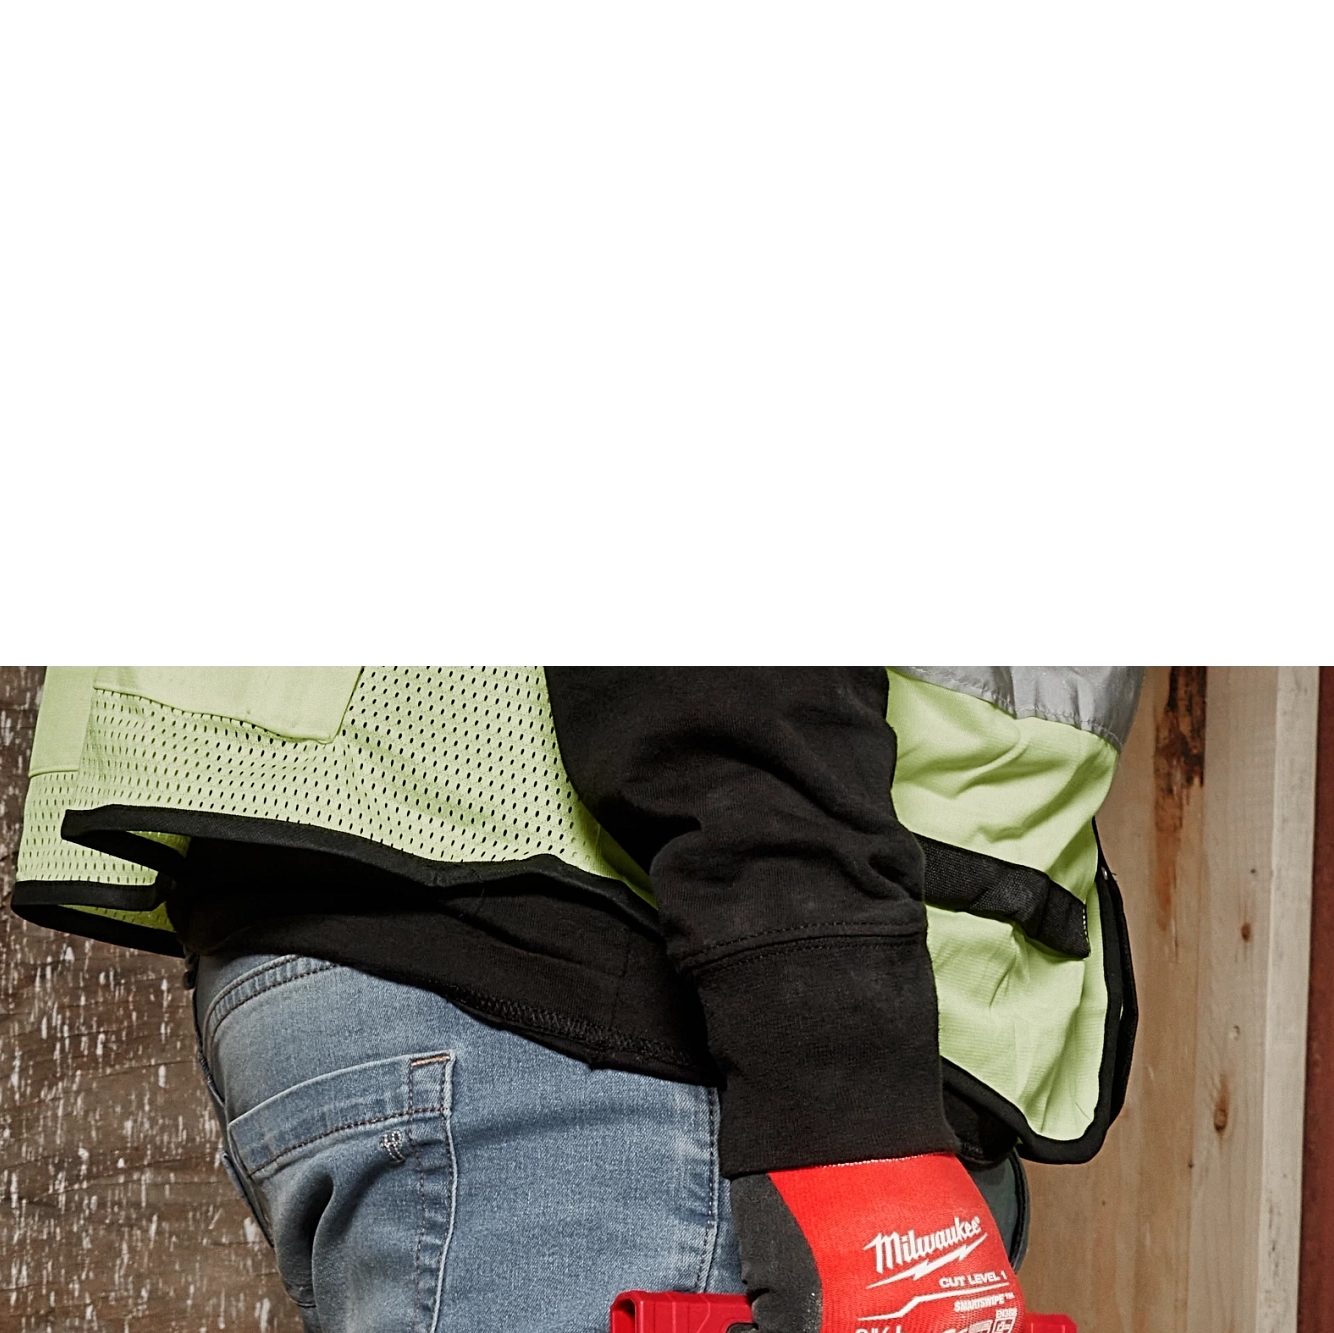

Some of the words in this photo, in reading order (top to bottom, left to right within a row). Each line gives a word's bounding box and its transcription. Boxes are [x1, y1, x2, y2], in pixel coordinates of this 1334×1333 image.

[939, 1276, 965, 1288] CUT
[968, 1272, 1000, 1285] LEVEL
[1001, 1270, 1008, 1280] 1
